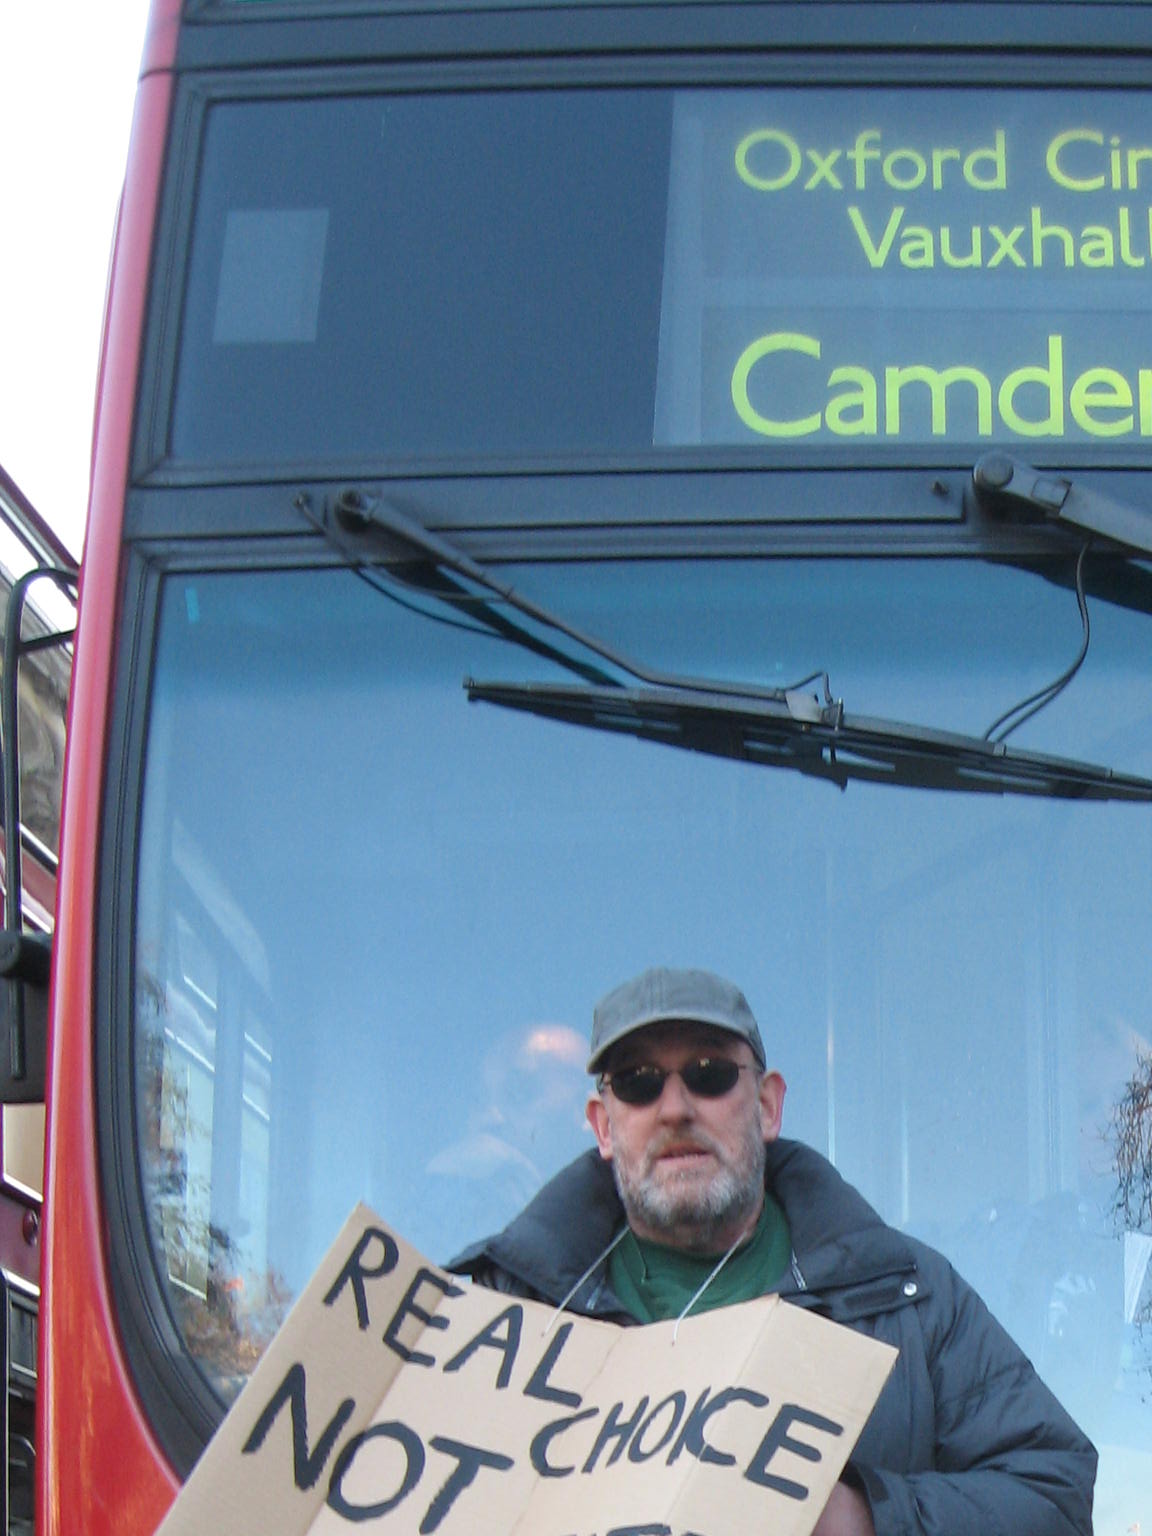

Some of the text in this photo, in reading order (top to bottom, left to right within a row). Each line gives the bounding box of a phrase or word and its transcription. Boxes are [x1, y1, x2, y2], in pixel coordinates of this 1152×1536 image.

[734, 130, 1007, 191] Oxford
[241, 1363, 513, 1535] NOT
[323, 1226, 844, 1502] REAL CHOICE
